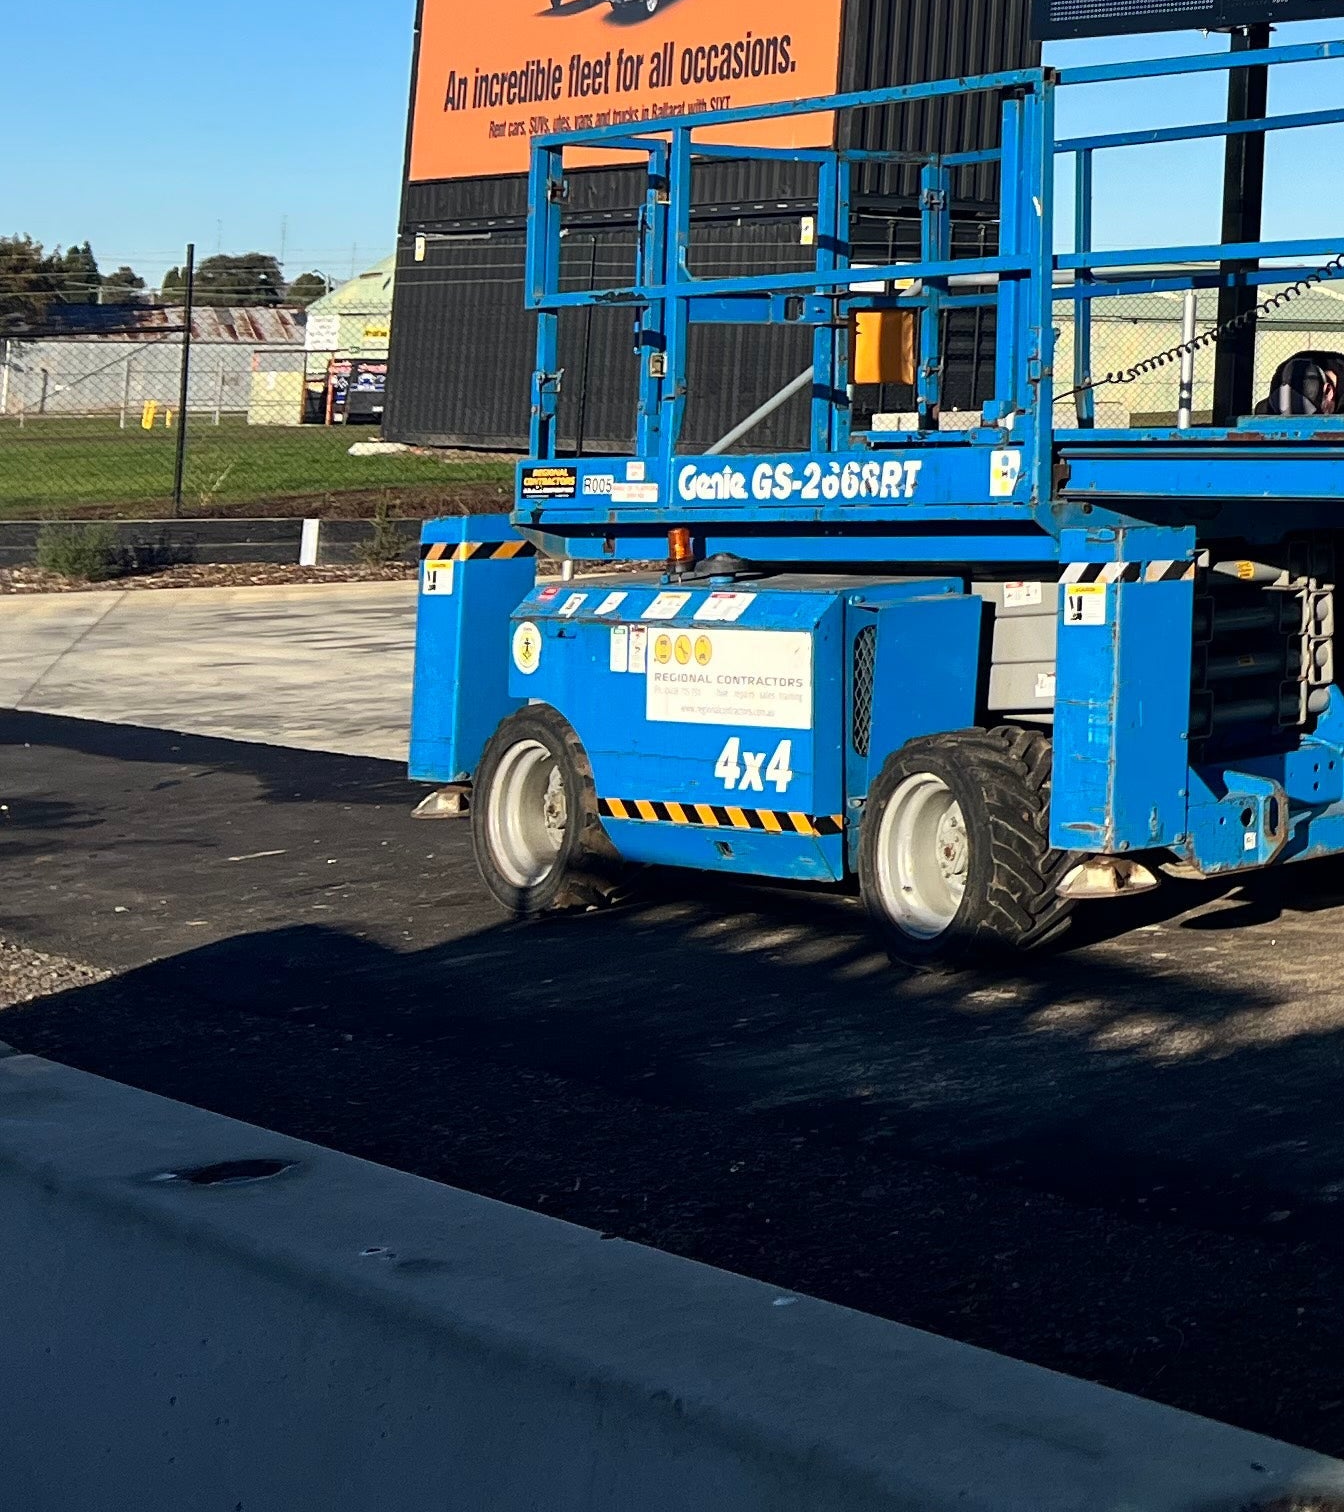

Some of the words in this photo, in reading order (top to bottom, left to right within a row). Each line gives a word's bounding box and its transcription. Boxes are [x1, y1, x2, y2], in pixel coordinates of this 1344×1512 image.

[444, 70, 468, 112] An
[472, 57, 563, 109] incredible
[568, 51, 612, 98] fleet
[616, 48, 645, 92] for
[649, 41, 675, 89] all
[681, 31, 796, 85] occasions.
[584, 477, 613, 493] R005
[678, 464, 748, 501] Genie
[654, 672, 712, 684] REGIONAL
[716, 675, 803, 688] CONTRACTORS
[714, 736, 793, 793] 4x4
